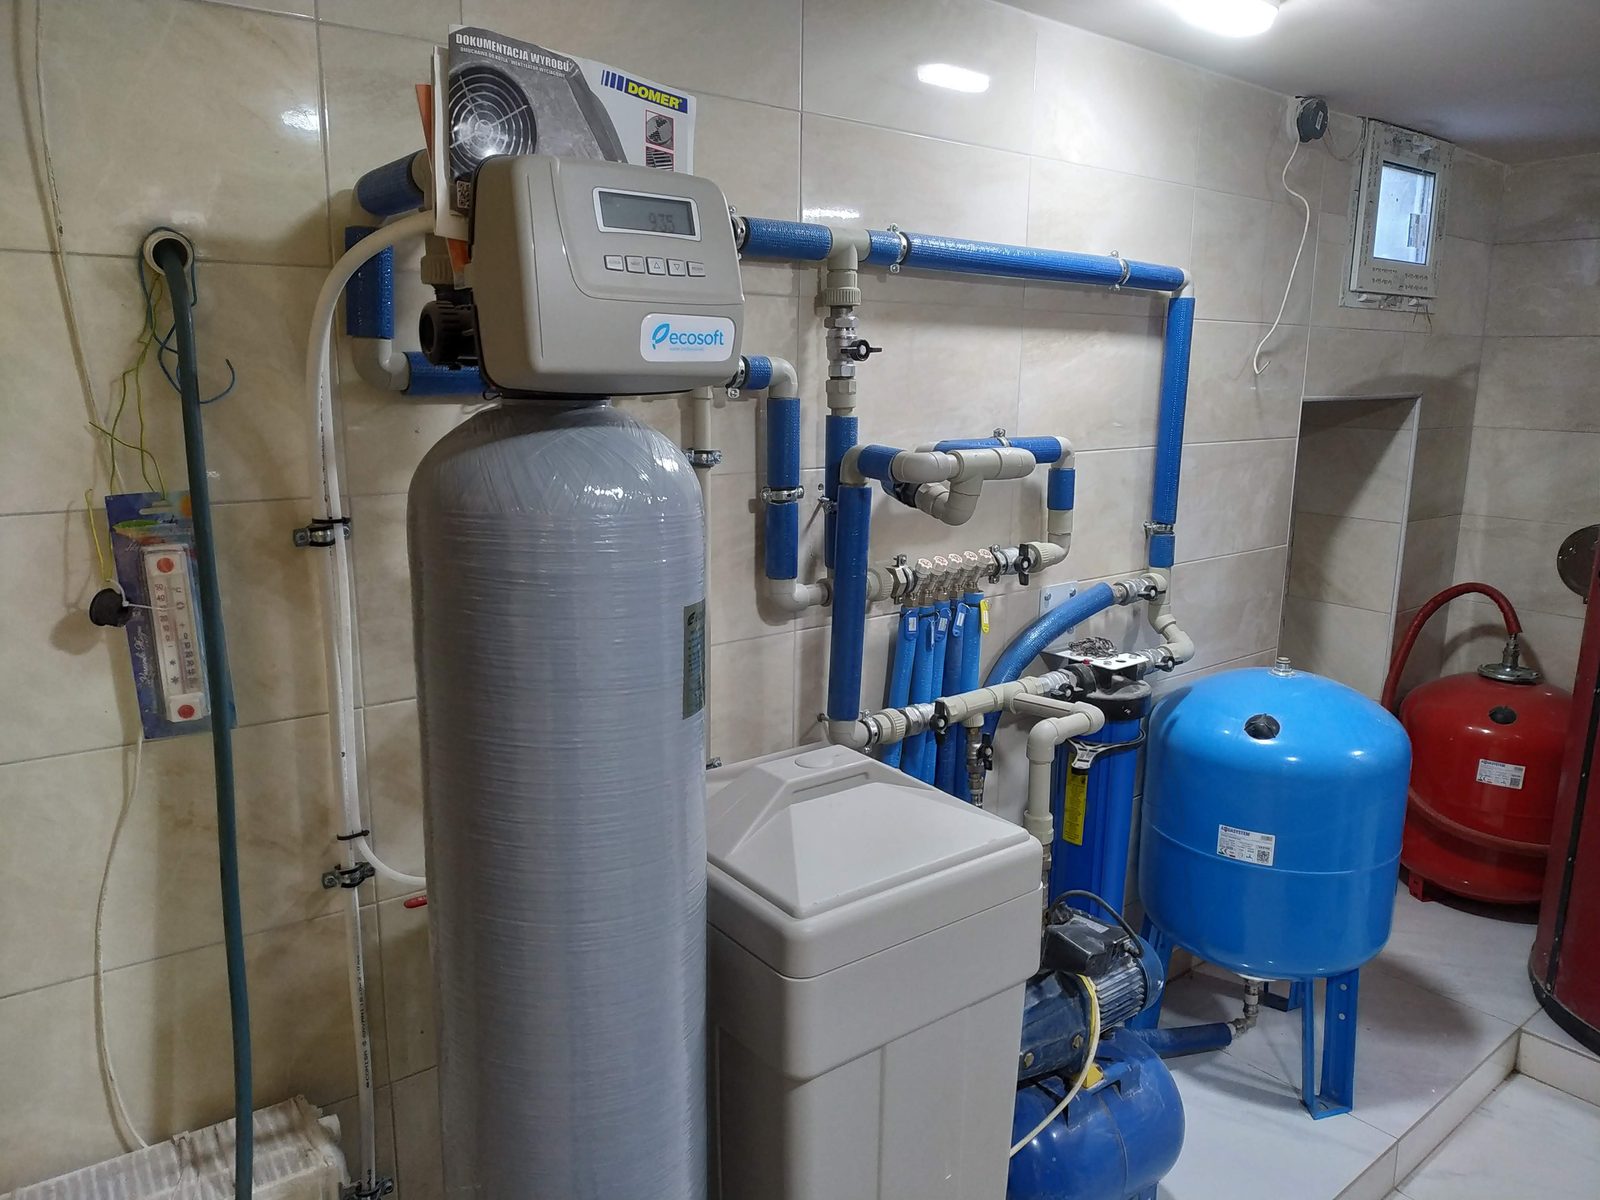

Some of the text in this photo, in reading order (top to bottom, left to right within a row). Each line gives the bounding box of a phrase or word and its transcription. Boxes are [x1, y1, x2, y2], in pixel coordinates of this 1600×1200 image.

[455, 33, 569, 72] DOKUMENTACJA WYROBU
[627, 81, 680, 110] DOMER
[669, 329, 724, 345] ecosoft
